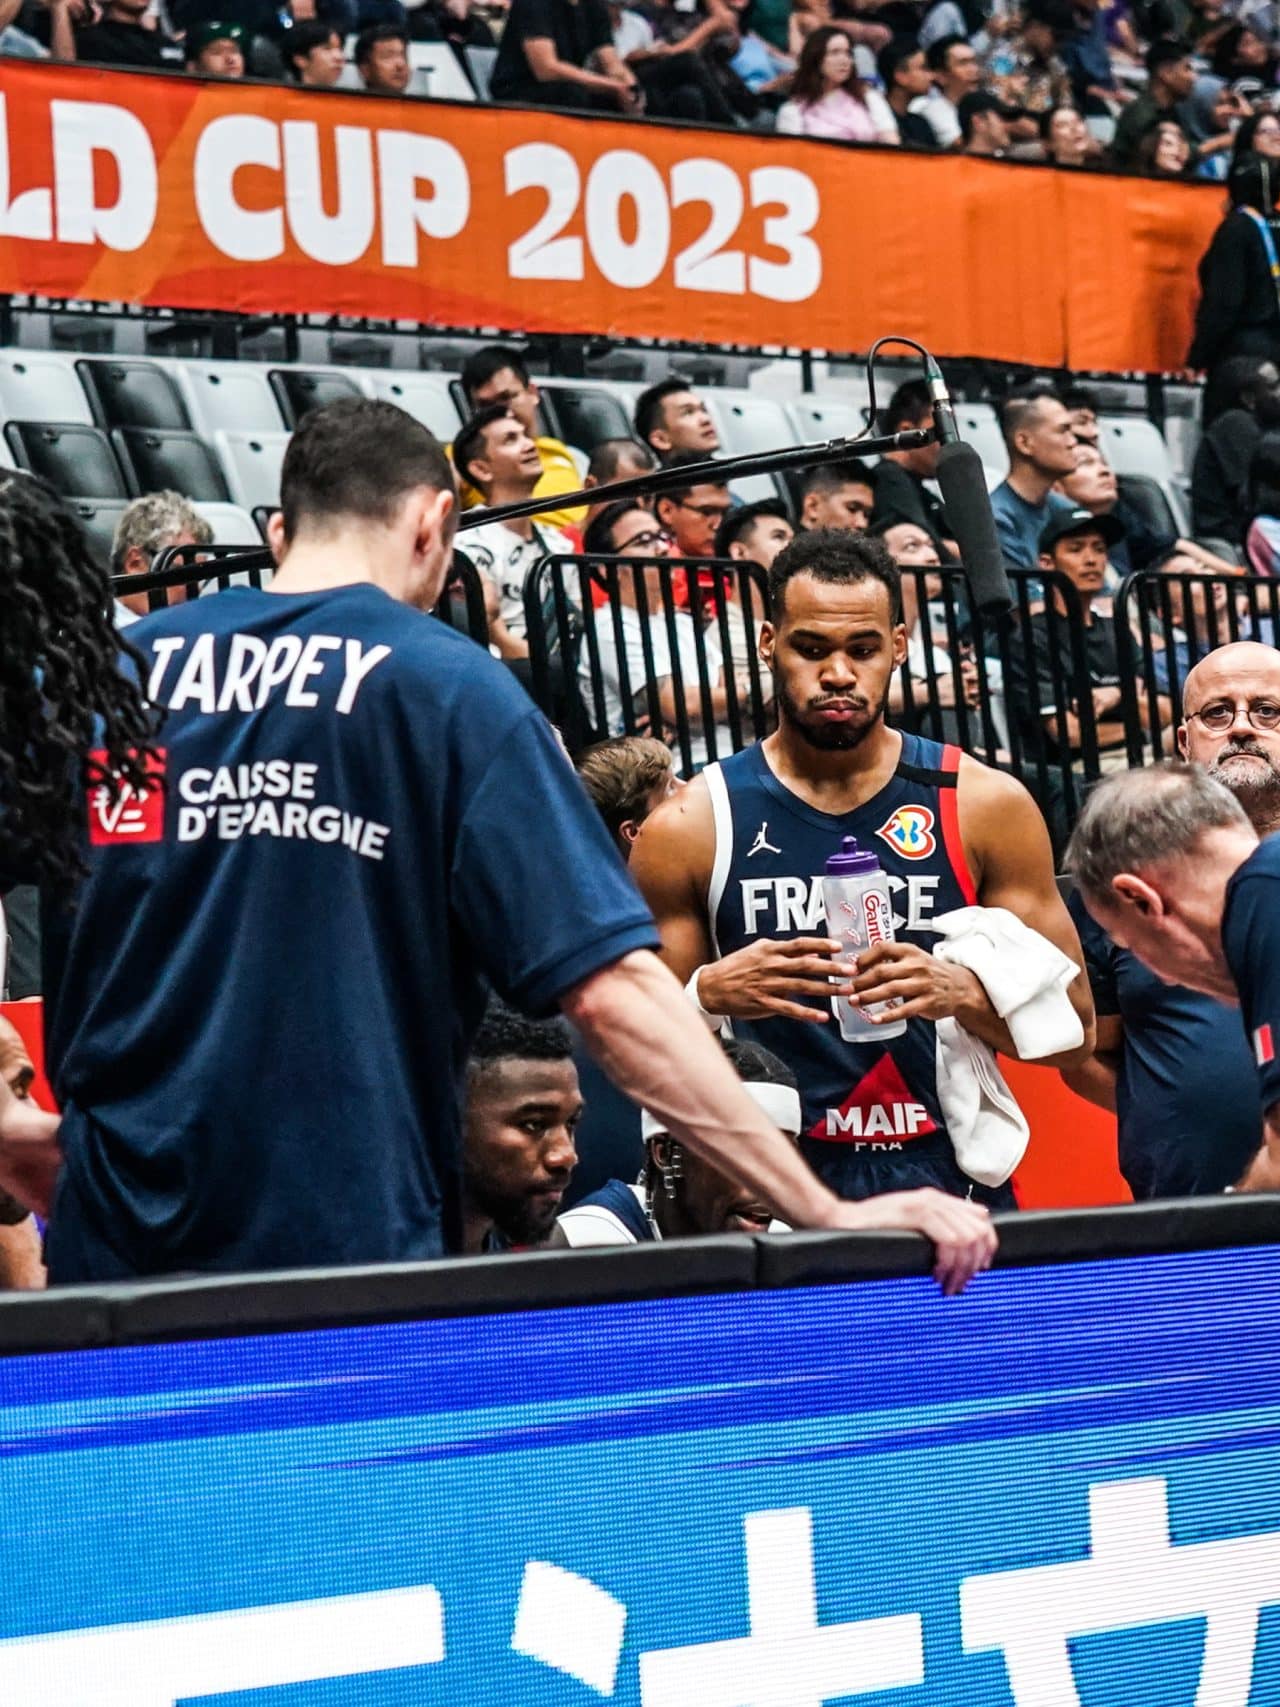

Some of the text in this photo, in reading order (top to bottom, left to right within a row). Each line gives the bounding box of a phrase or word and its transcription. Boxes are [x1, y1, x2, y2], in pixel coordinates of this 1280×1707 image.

[195, 114, 470, 268] CUP
[505, 142, 823, 303] 2023
[142, 633, 392, 715] TARPEY
[179, 760, 319, 804] CAISSE
[739, 875, 941, 935] FRACE
[826, 1102, 928, 1137] MAIF
